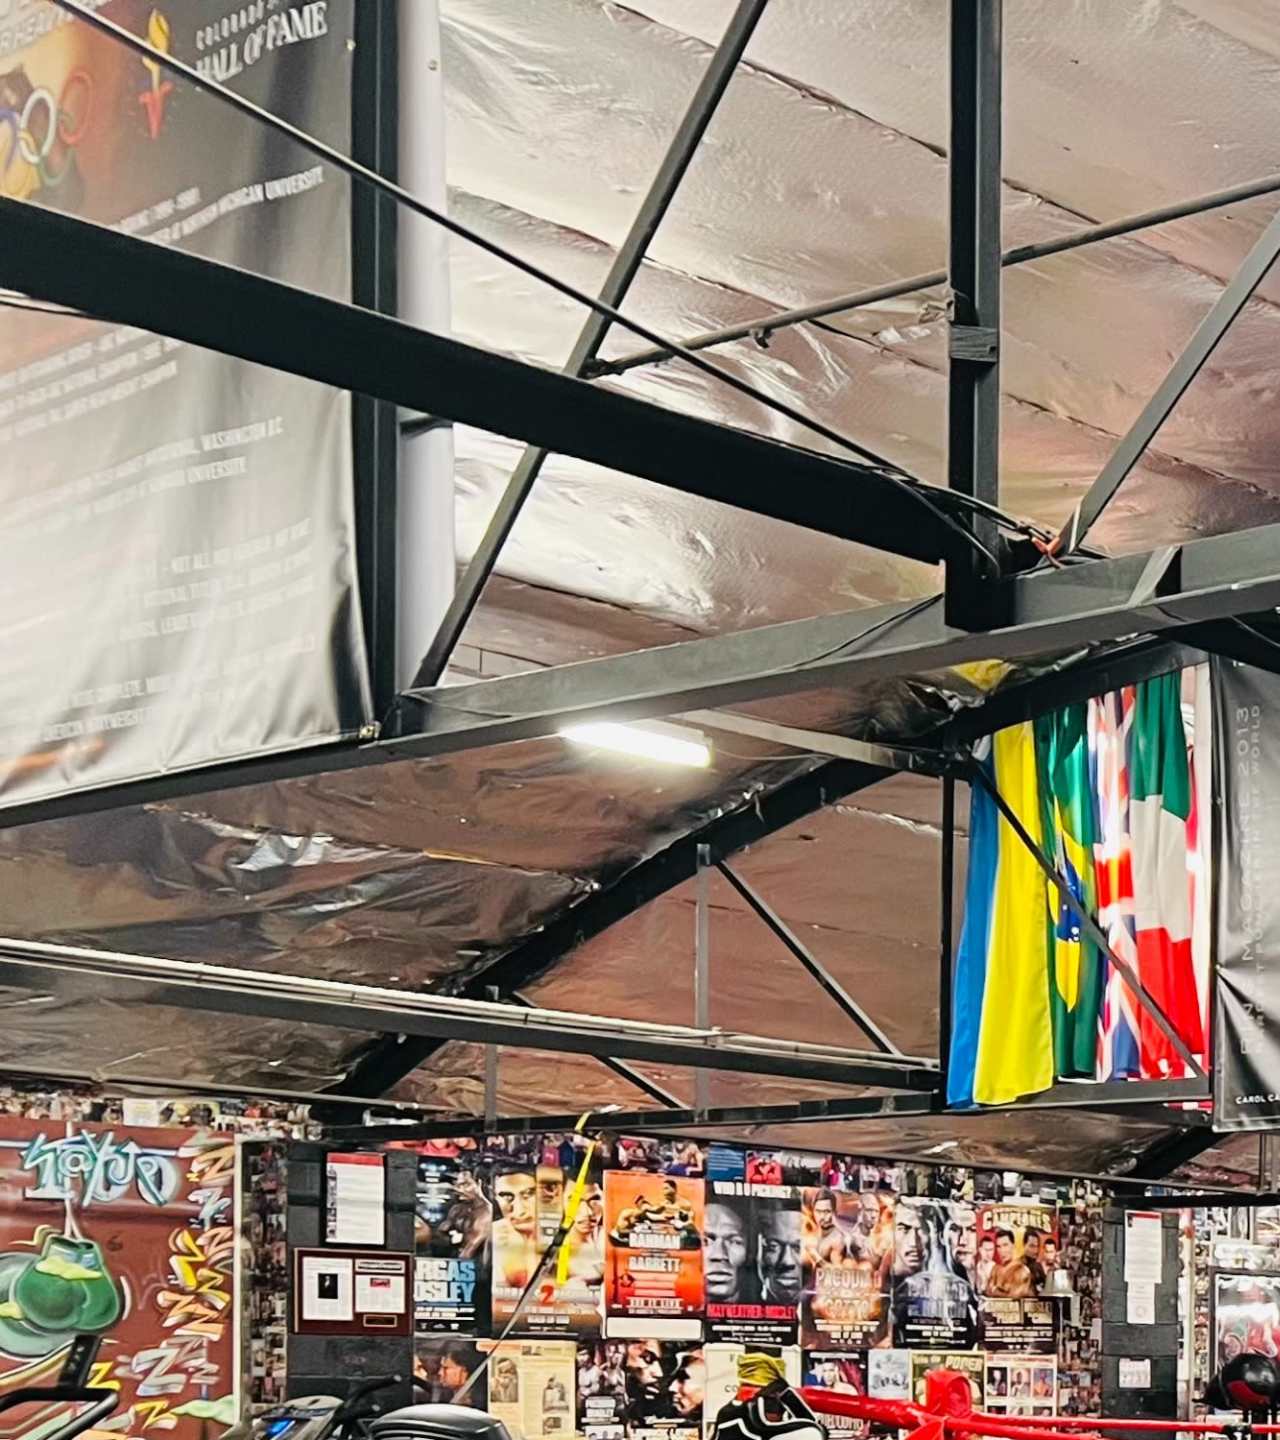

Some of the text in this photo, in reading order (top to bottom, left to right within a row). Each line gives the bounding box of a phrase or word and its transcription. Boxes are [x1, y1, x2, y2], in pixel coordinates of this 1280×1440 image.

[244, 23, 267, 65] OF
[266, 1, 328, 50] FAME
[1235, 706, 1250, 777] 2013
[1251, 704, 1261, 775] WORLD
[1236, 1095, 1266, 1105] CAROL
[540, 1284, 554, 1305] 2
